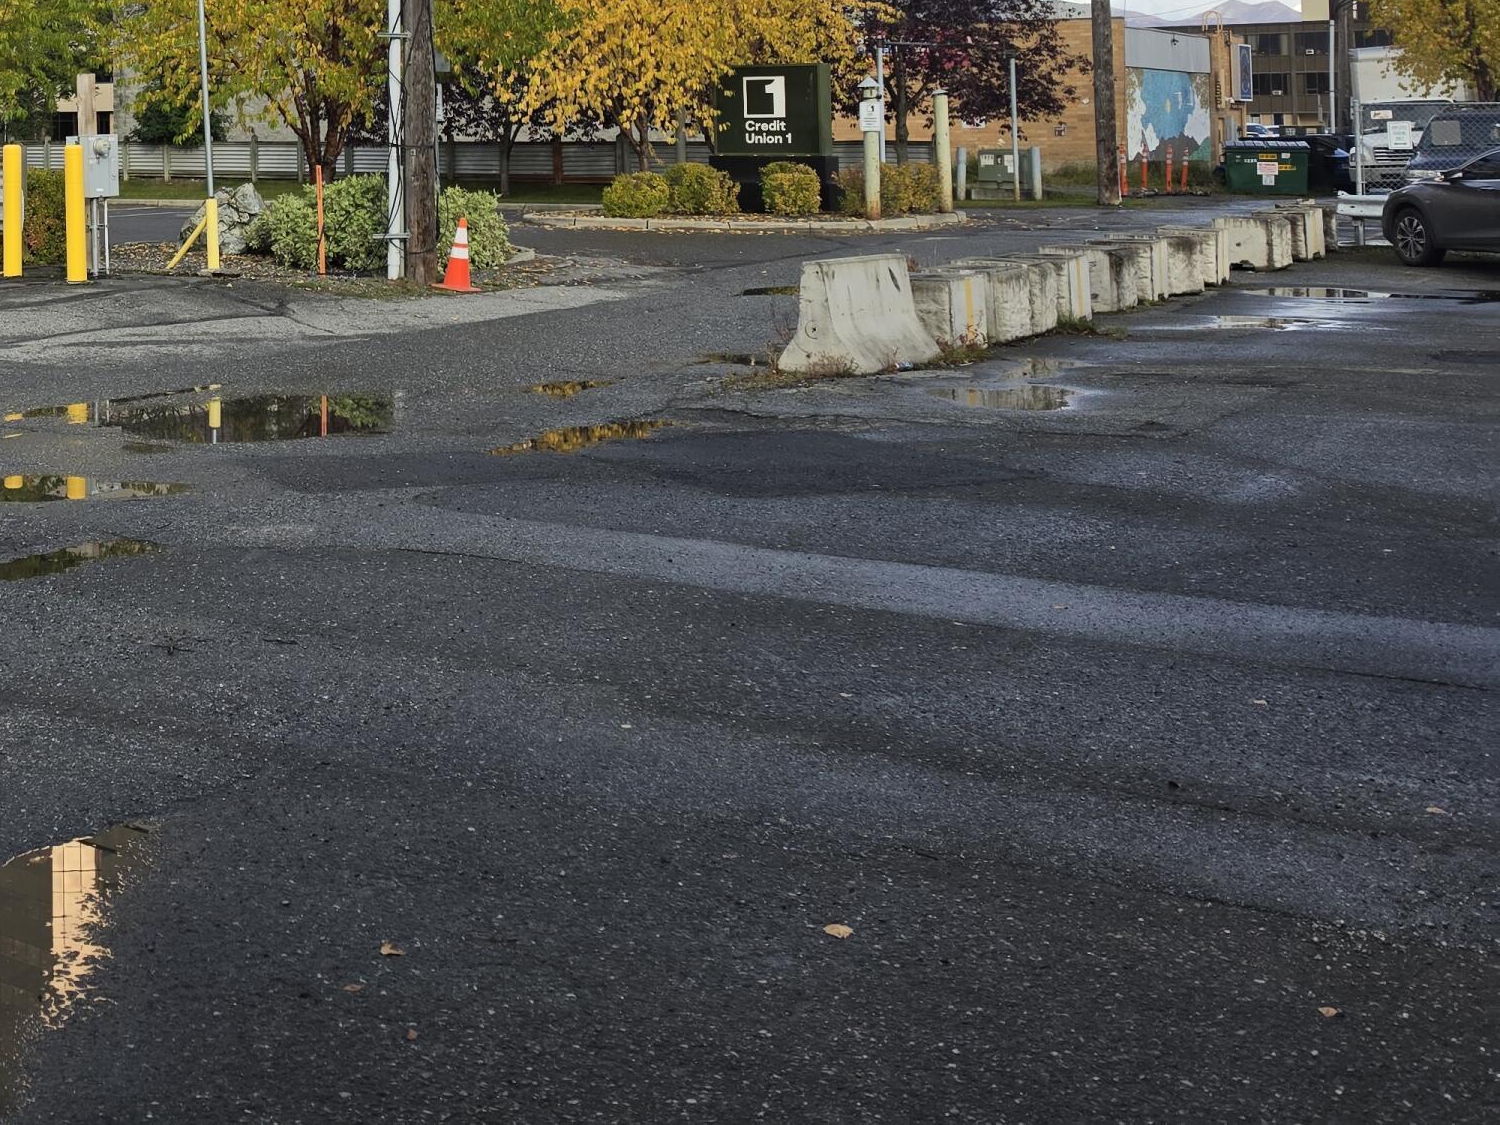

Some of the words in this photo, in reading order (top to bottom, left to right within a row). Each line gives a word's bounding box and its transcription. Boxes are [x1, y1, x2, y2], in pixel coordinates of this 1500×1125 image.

[745, 120, 786, 131] Credit
[745, 132, 783, 144] Union
[785, 132, 792, 144] 1
